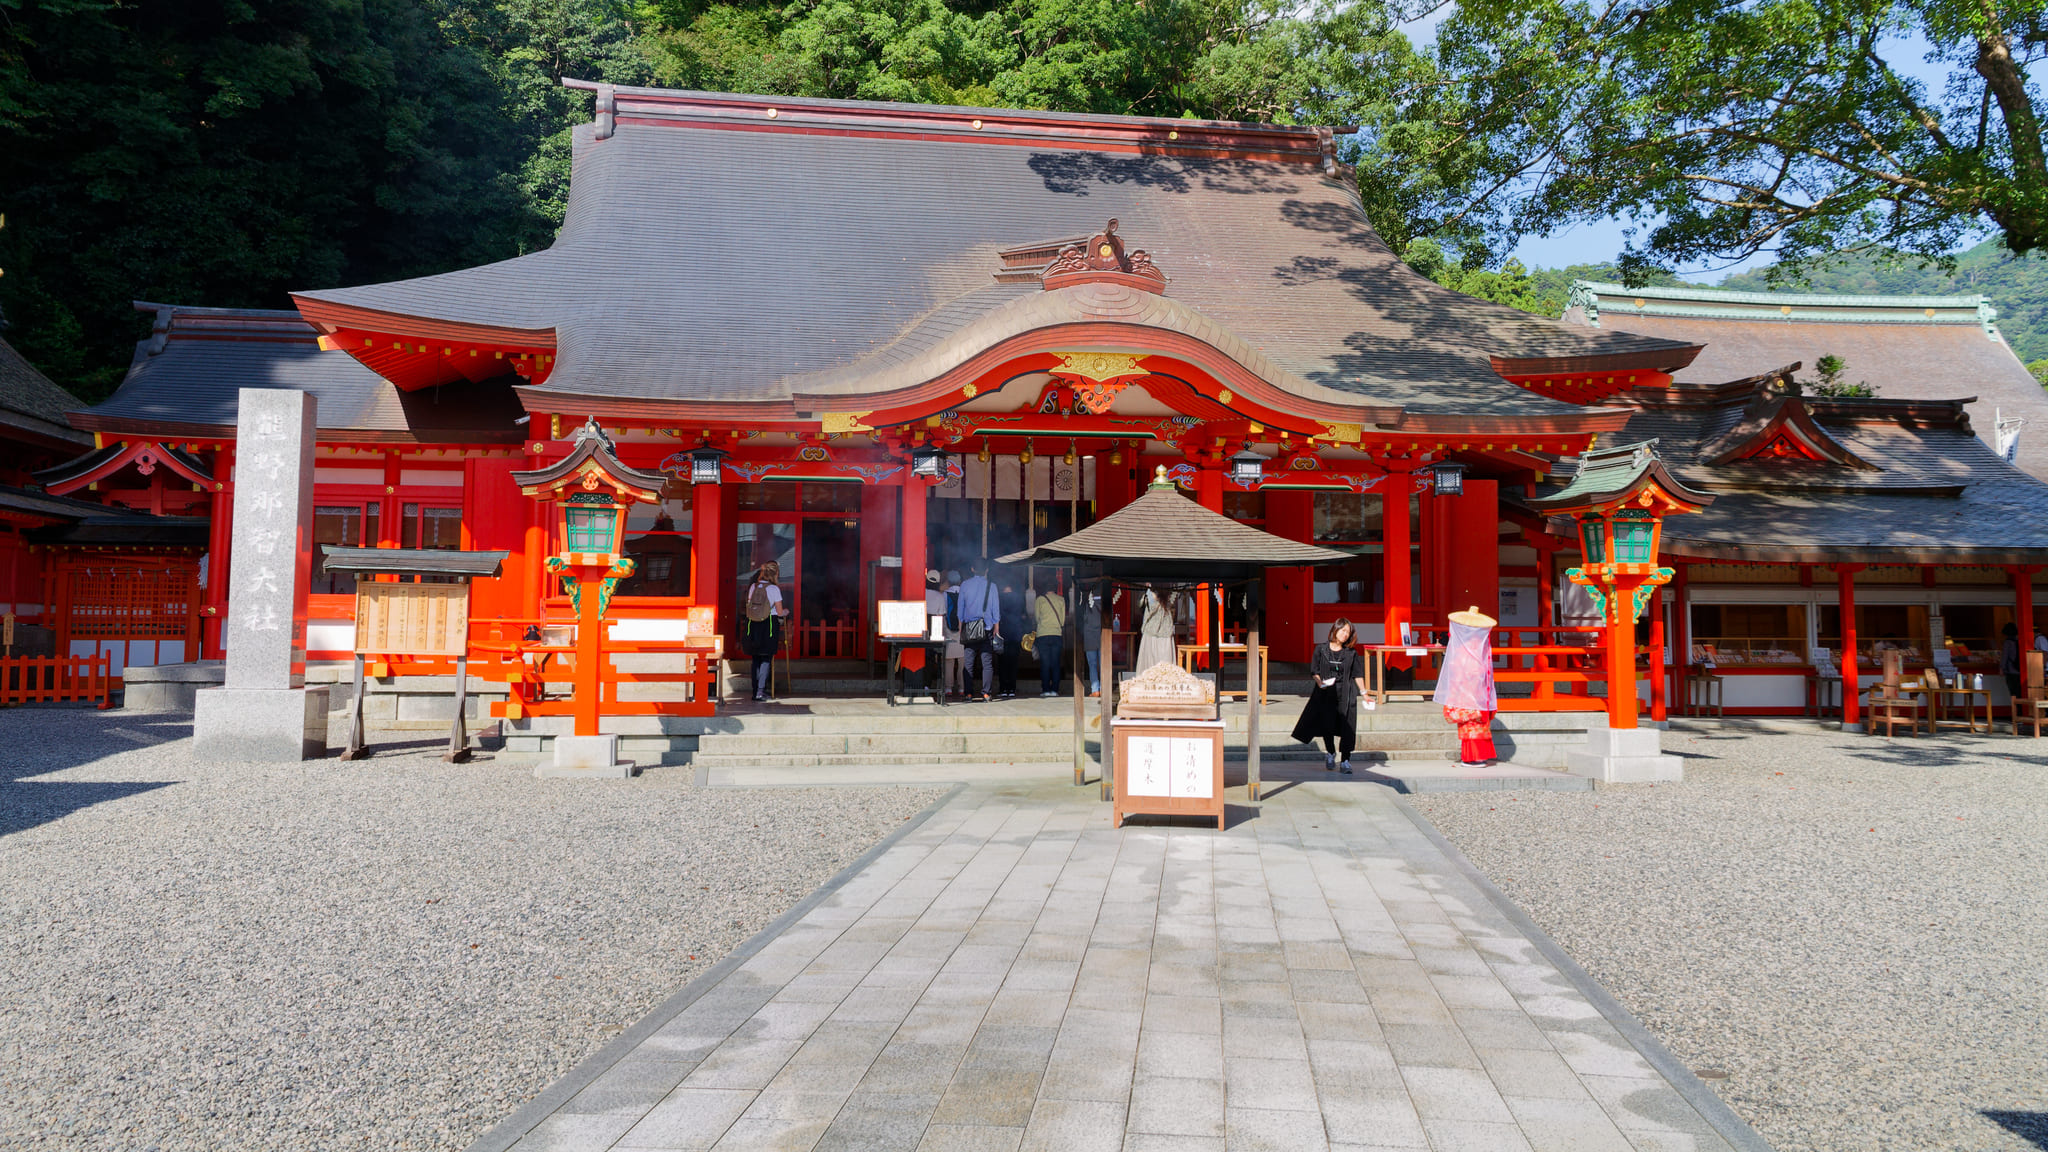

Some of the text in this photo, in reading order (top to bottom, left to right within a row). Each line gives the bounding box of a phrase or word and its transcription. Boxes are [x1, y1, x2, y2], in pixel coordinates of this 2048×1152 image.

[244, 413, 287, 632] 熊野那智大社
[1144, 743, 1154, 784] 護摩木
[1186, 742, 1197, 793] お清めの
